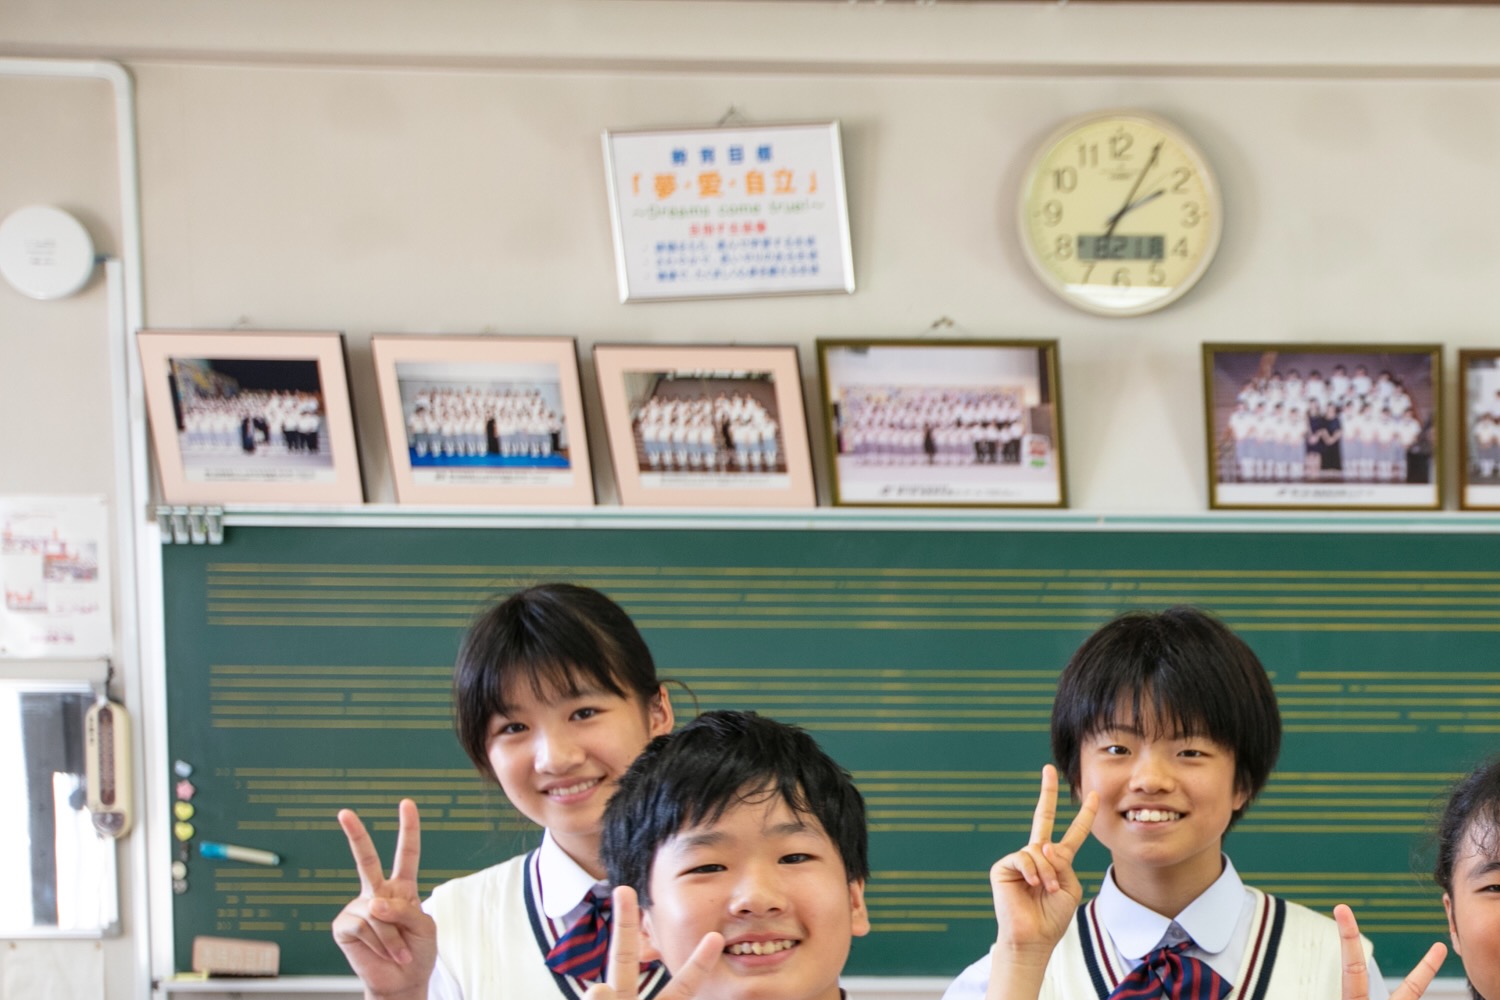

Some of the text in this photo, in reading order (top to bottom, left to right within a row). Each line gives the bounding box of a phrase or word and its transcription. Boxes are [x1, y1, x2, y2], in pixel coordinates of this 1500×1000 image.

[1078, 143, 1099, 168] 11
[1108, 131, 1134, 160] 12
[1053, 165, 1078, 193] 10
[1171, 166, 1192, 193] 2
[1043, 199, 1063, 227] 9
[1181, 200, 1201, 228] 3
[1055, 233, 1073, 261] 8
[1172, 236, 1188, 257] 4
[1112, 267, 1131, 289] 6
[1147, 262, 1166, 287] 5
